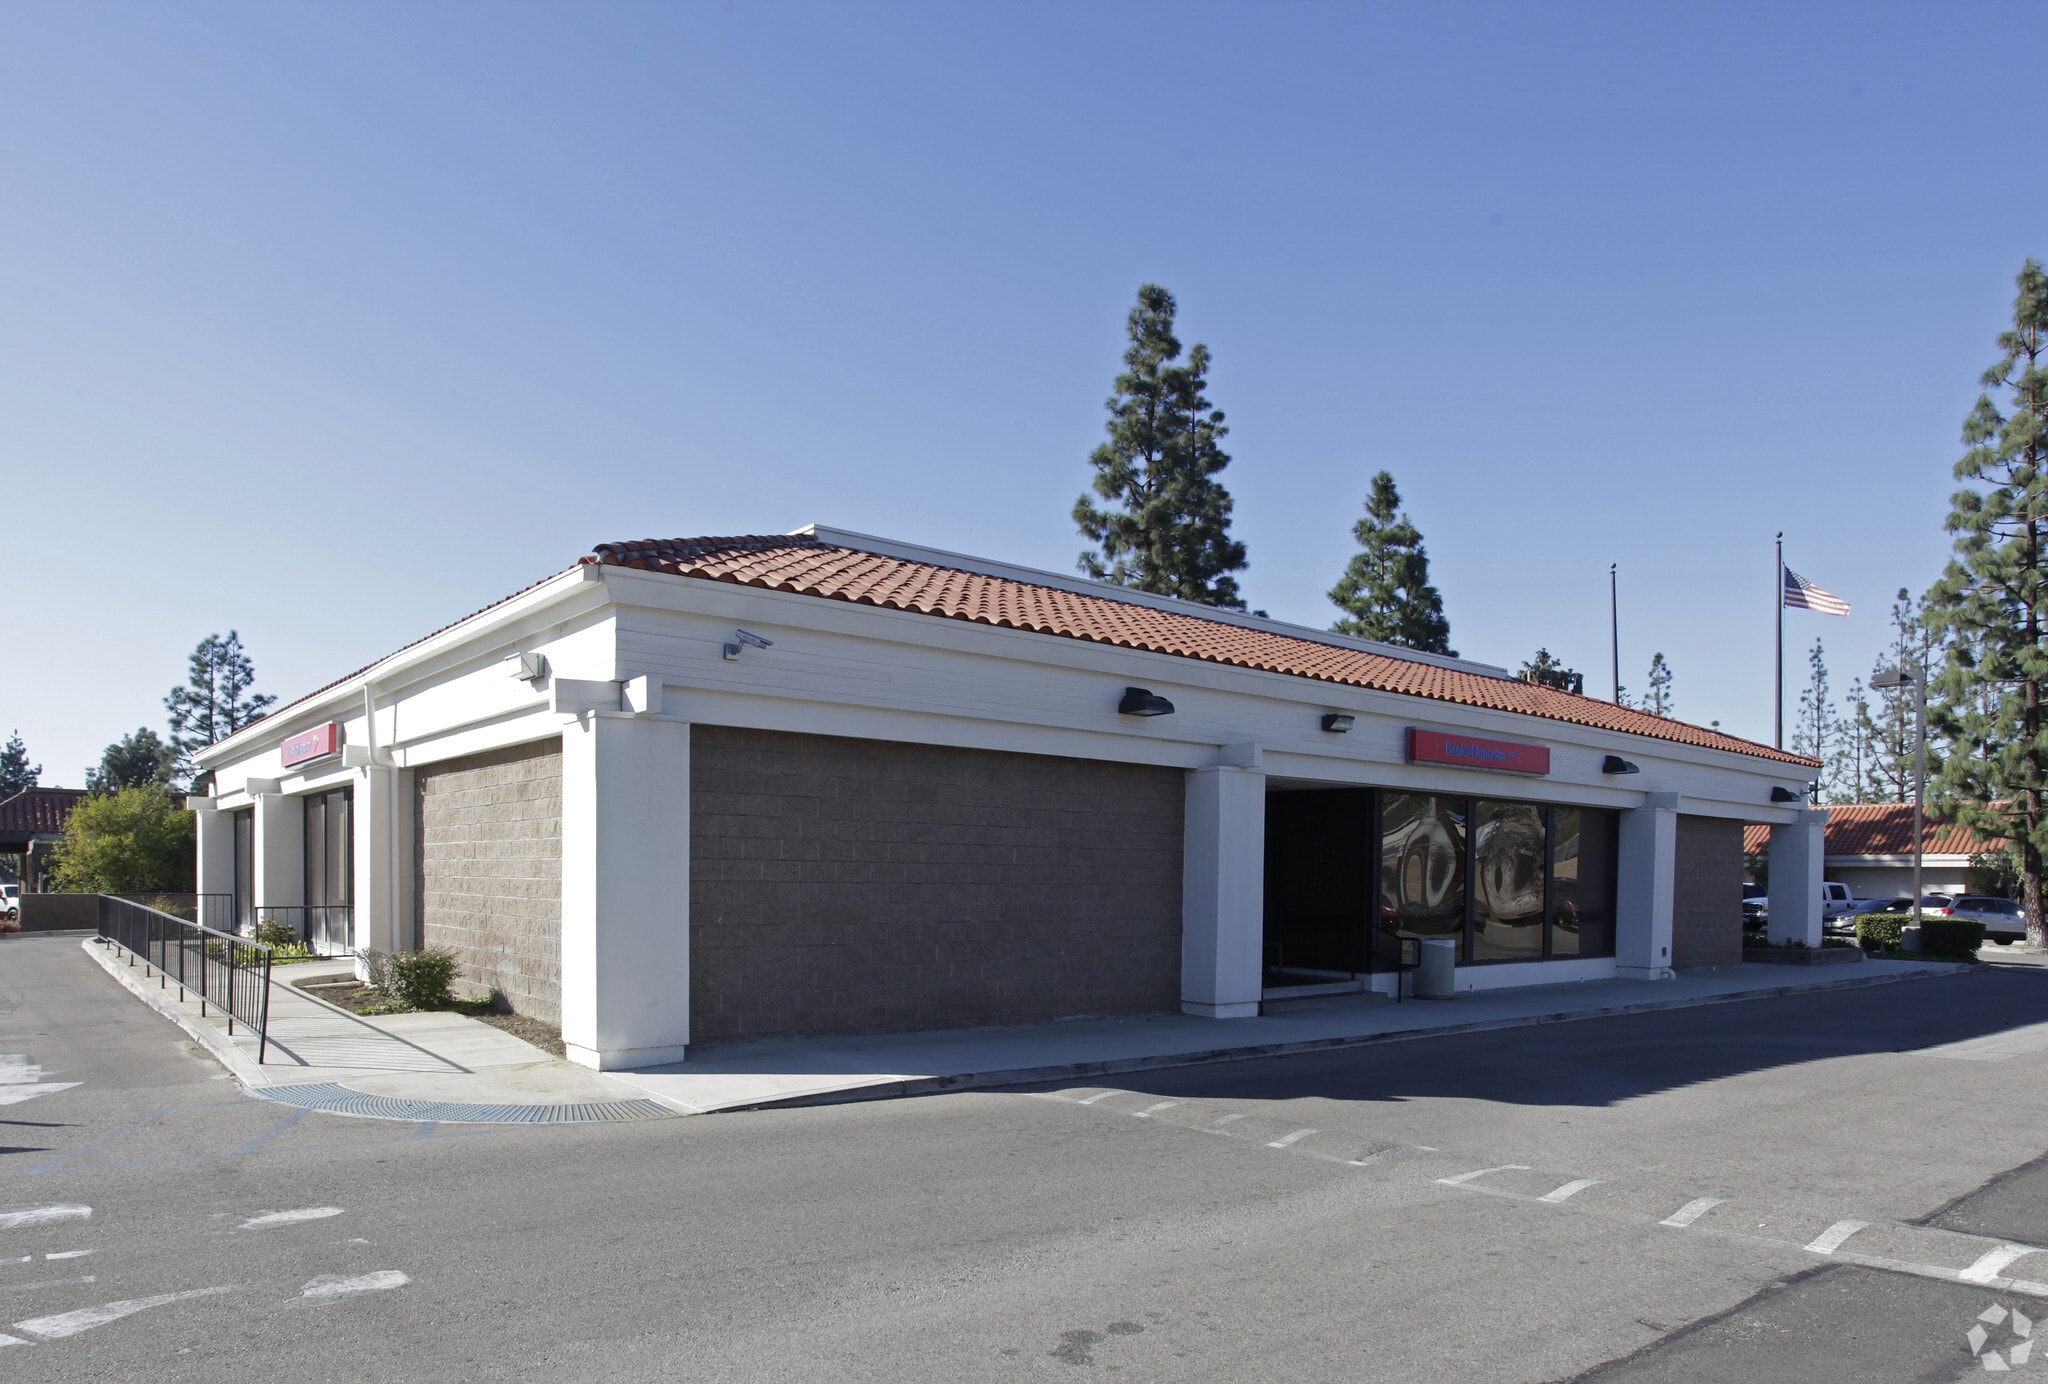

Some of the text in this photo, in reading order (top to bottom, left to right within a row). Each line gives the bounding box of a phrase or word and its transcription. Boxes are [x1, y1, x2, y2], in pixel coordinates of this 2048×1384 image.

[1446, 740, 1507, 762] Bank of America
